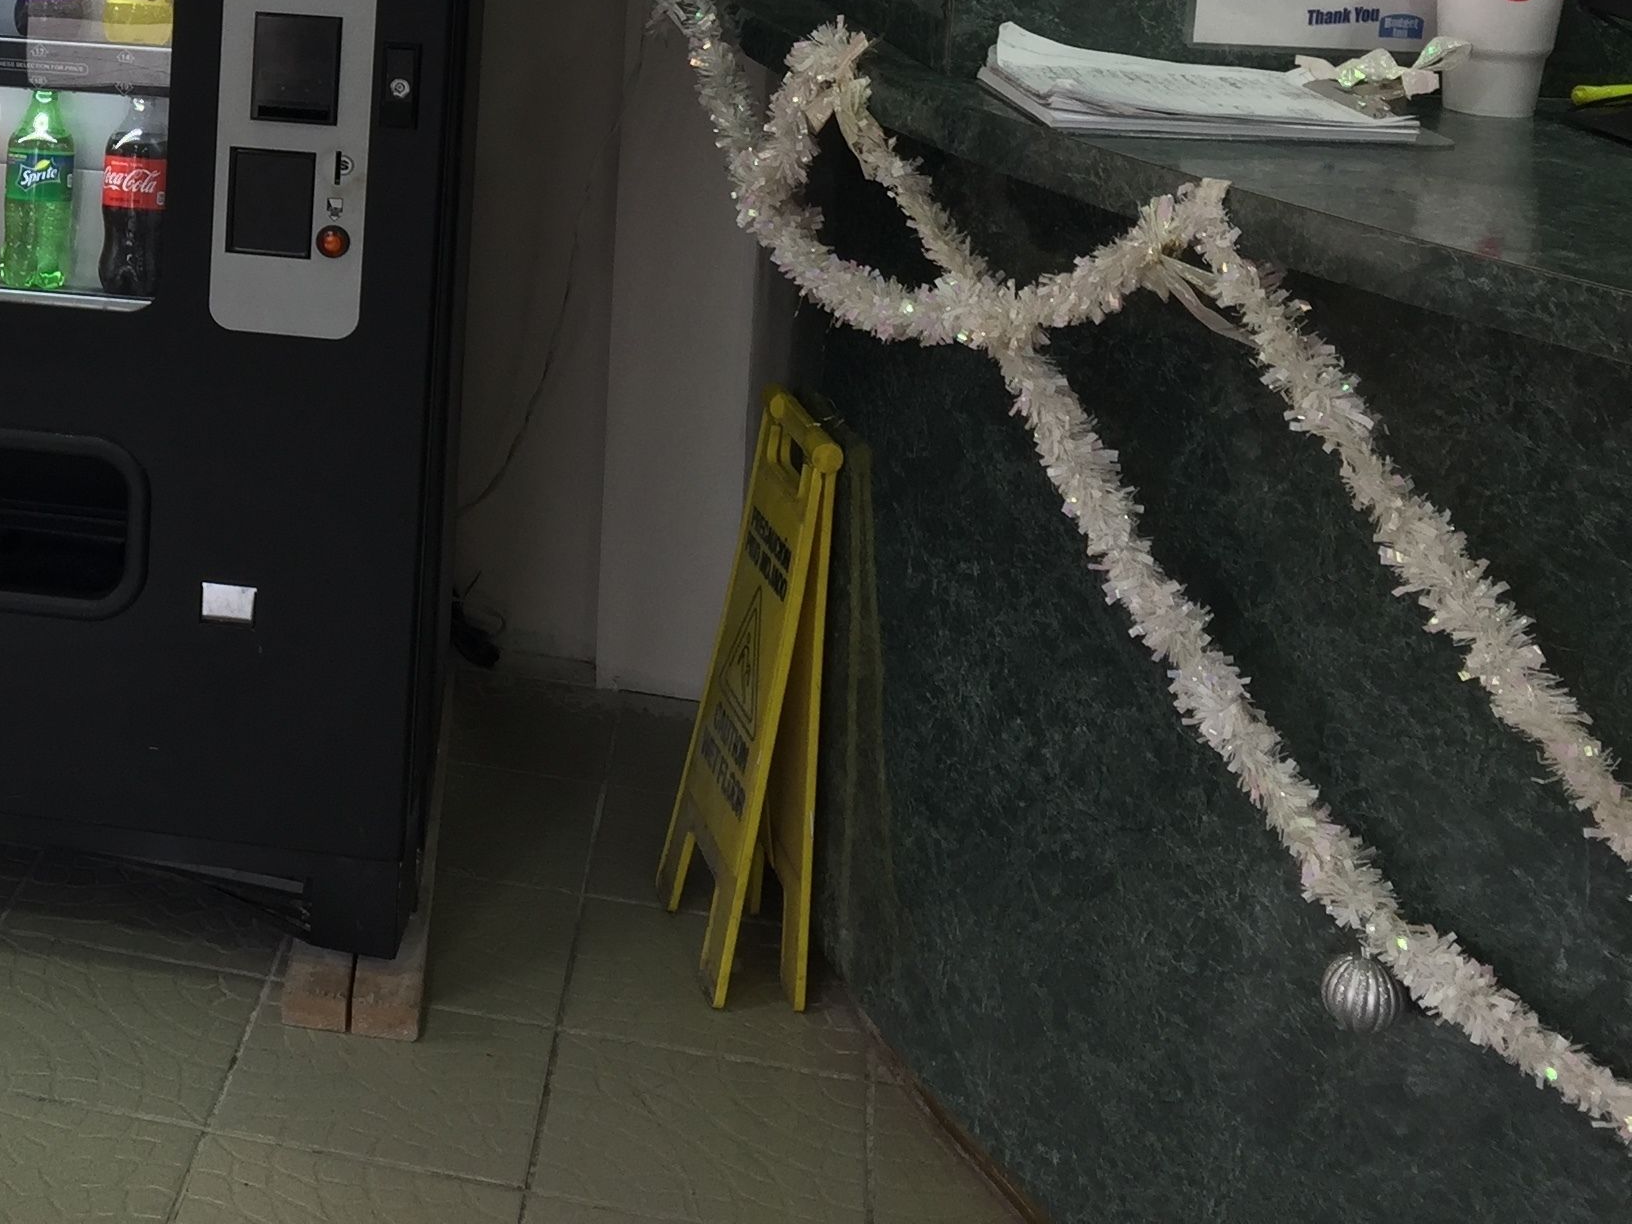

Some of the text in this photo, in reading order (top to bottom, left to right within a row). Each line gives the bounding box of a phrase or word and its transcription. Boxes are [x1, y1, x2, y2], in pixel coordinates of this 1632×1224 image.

[1307, 6, 1380, 26] Thank You
[20, 167, 58, 185] Sprite
